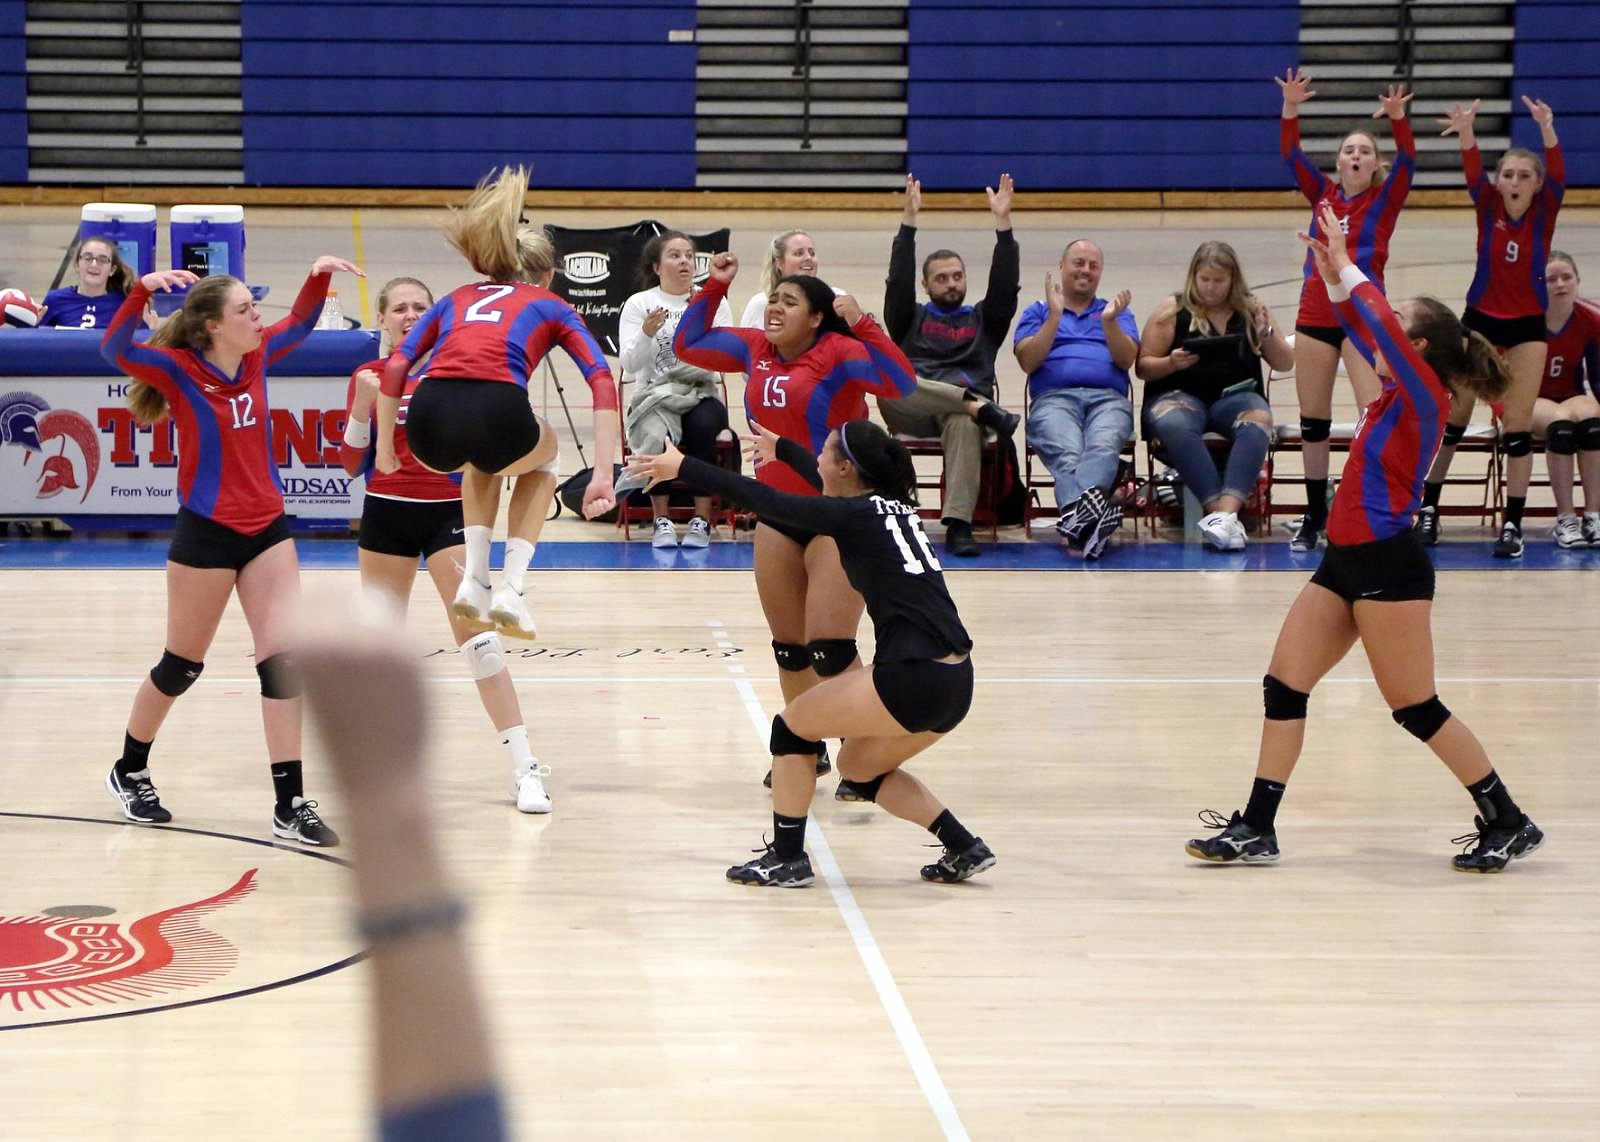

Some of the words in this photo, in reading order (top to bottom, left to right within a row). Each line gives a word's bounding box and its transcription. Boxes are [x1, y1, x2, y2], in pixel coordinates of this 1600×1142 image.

[1505, 240, 1519, 262] 9
[464, 284, 515, 322] 2
[80, 313, 96, 329] 2
[1550, 356, 1564, 377] 6
[763, 375, 790, 407] 15
[229, 392, 257, 429] 12
[111, 486, 142, 497] From
[146, 486, 173, 497] Your
[423, 647, 600, 659] Llod
